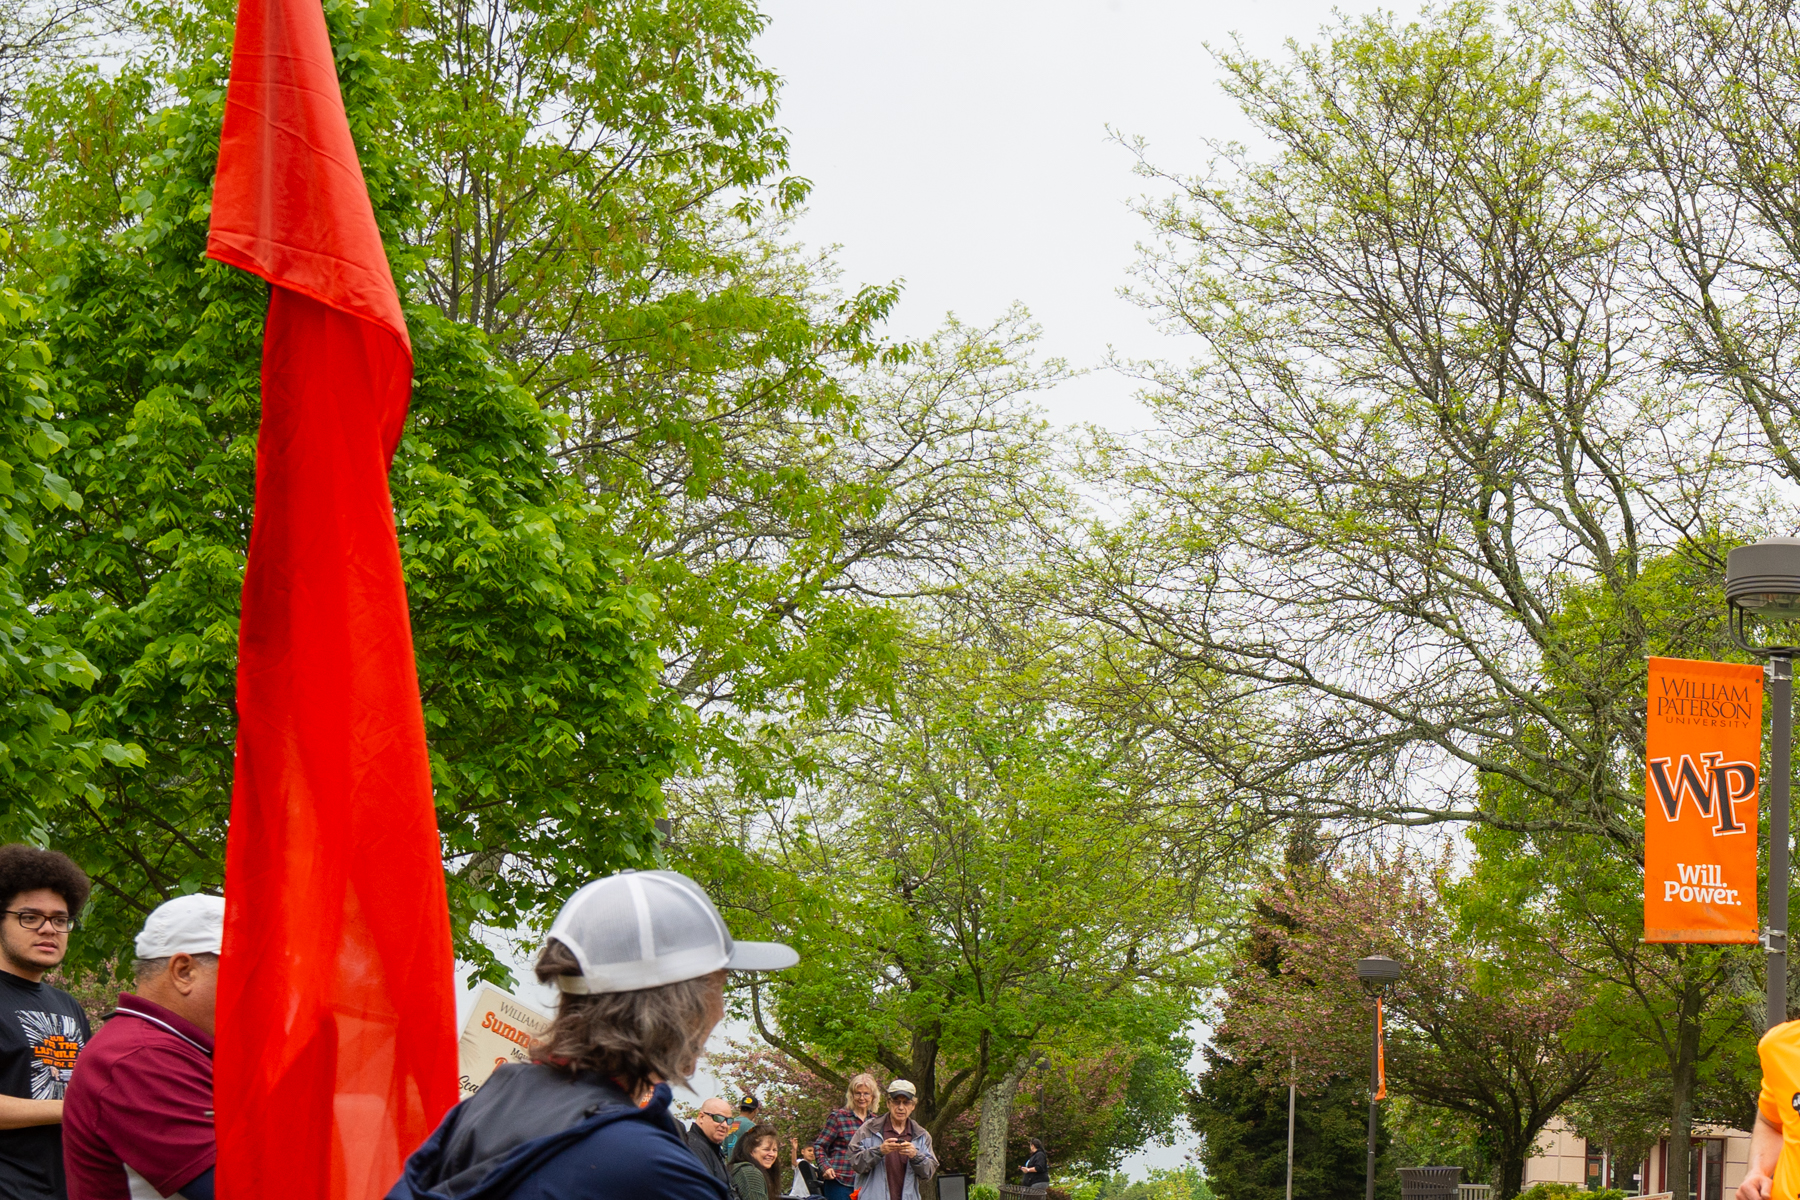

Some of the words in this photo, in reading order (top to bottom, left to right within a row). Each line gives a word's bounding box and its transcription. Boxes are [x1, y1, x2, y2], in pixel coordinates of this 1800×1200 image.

[1660, 676, 1749, 703] WILLIAM
[1657, 696, 1752, 721] PATERSON
[1665, 716, 1750, 729] UNIVERSITY
[1650, 750, 1756, 837] WP
[1676, 863, 1728, 888] Will.
[1663, 880, 1742, 906] Power.
[500, 1001, 540, 1030] WILLIAM
[58, 1042, 78, 1050] THE
